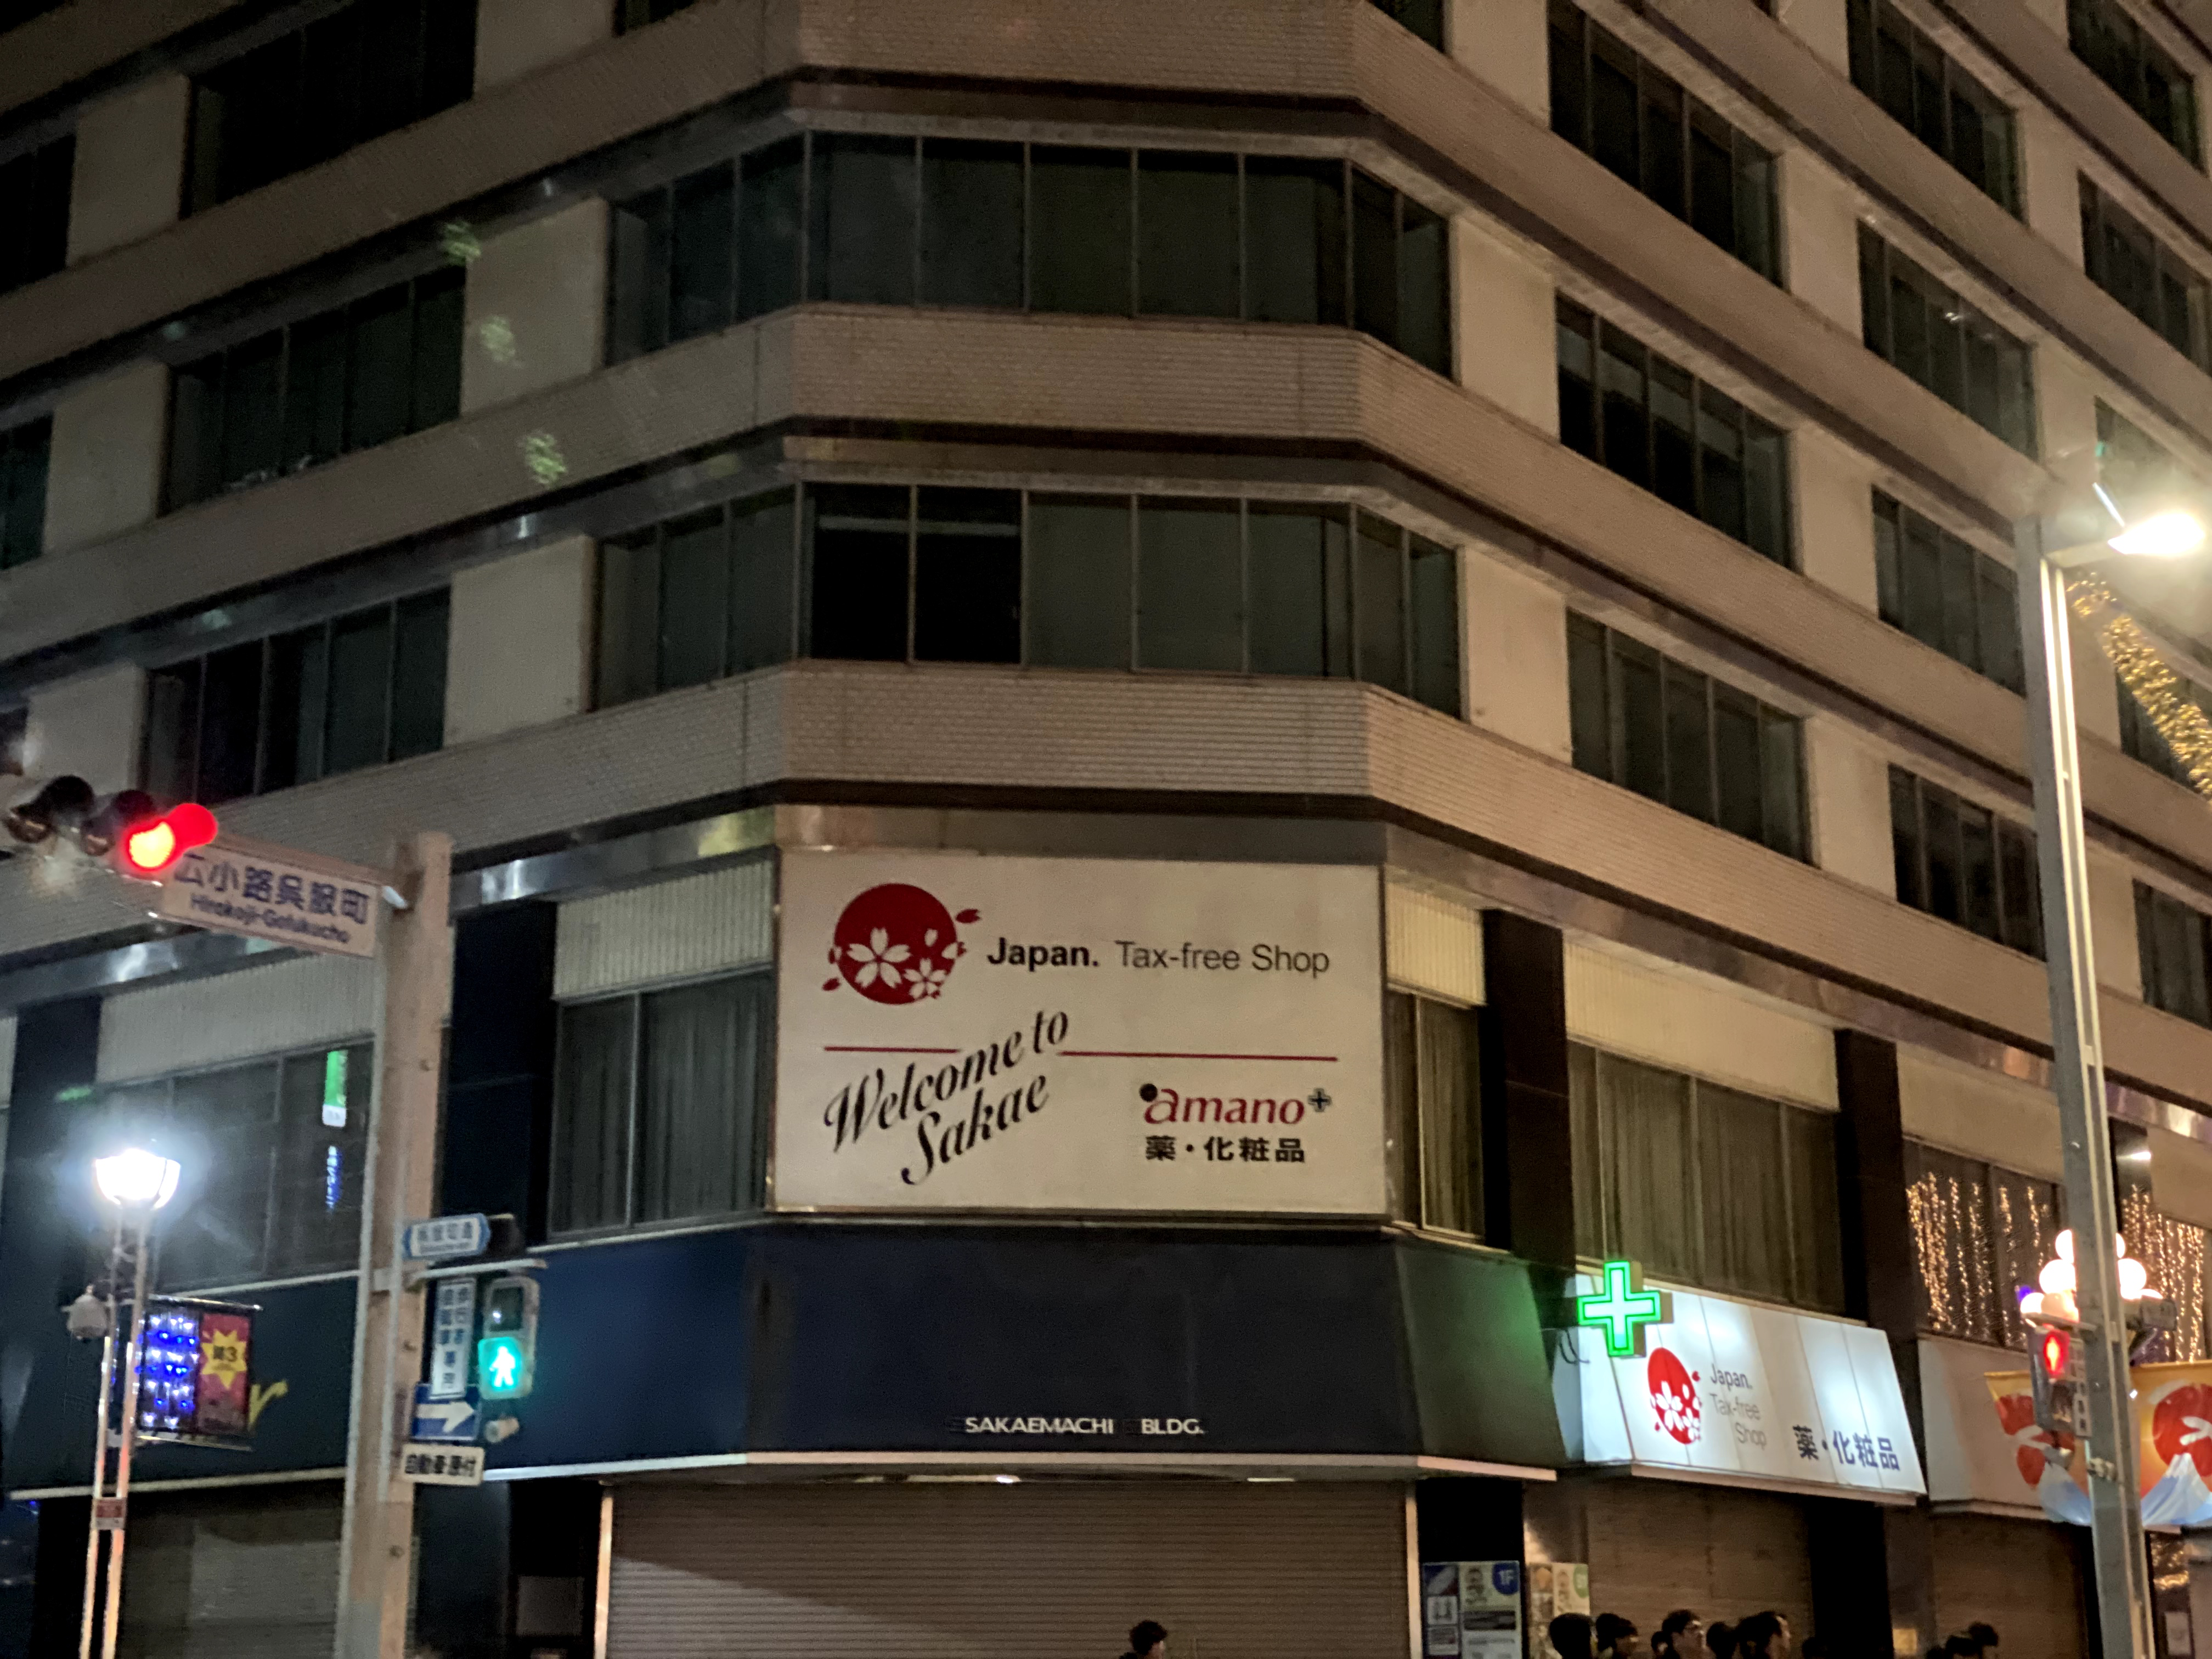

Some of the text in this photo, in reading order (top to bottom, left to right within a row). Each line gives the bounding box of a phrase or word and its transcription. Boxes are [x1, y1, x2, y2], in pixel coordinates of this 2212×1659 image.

[987, 936, 1330, 979] Japan. Tax-free Shop
[823, 1010, 1069, 1153] Welcome to
[900, 1074, 1050, 1186] Sakae
[1144, 1134, 1305, 1163] 薬・化粧品
[1709, 1363, 1754, 1392] Japan.
[1709, 1392, 1762, 1422] Tax-free
[964, 1417, 1205, 1435] SAKAEMACHI BLDG.
[1734, 1422, 1768, 1451] Shop
[1792, 1424, 1901, 1472] 薬・化粧品
